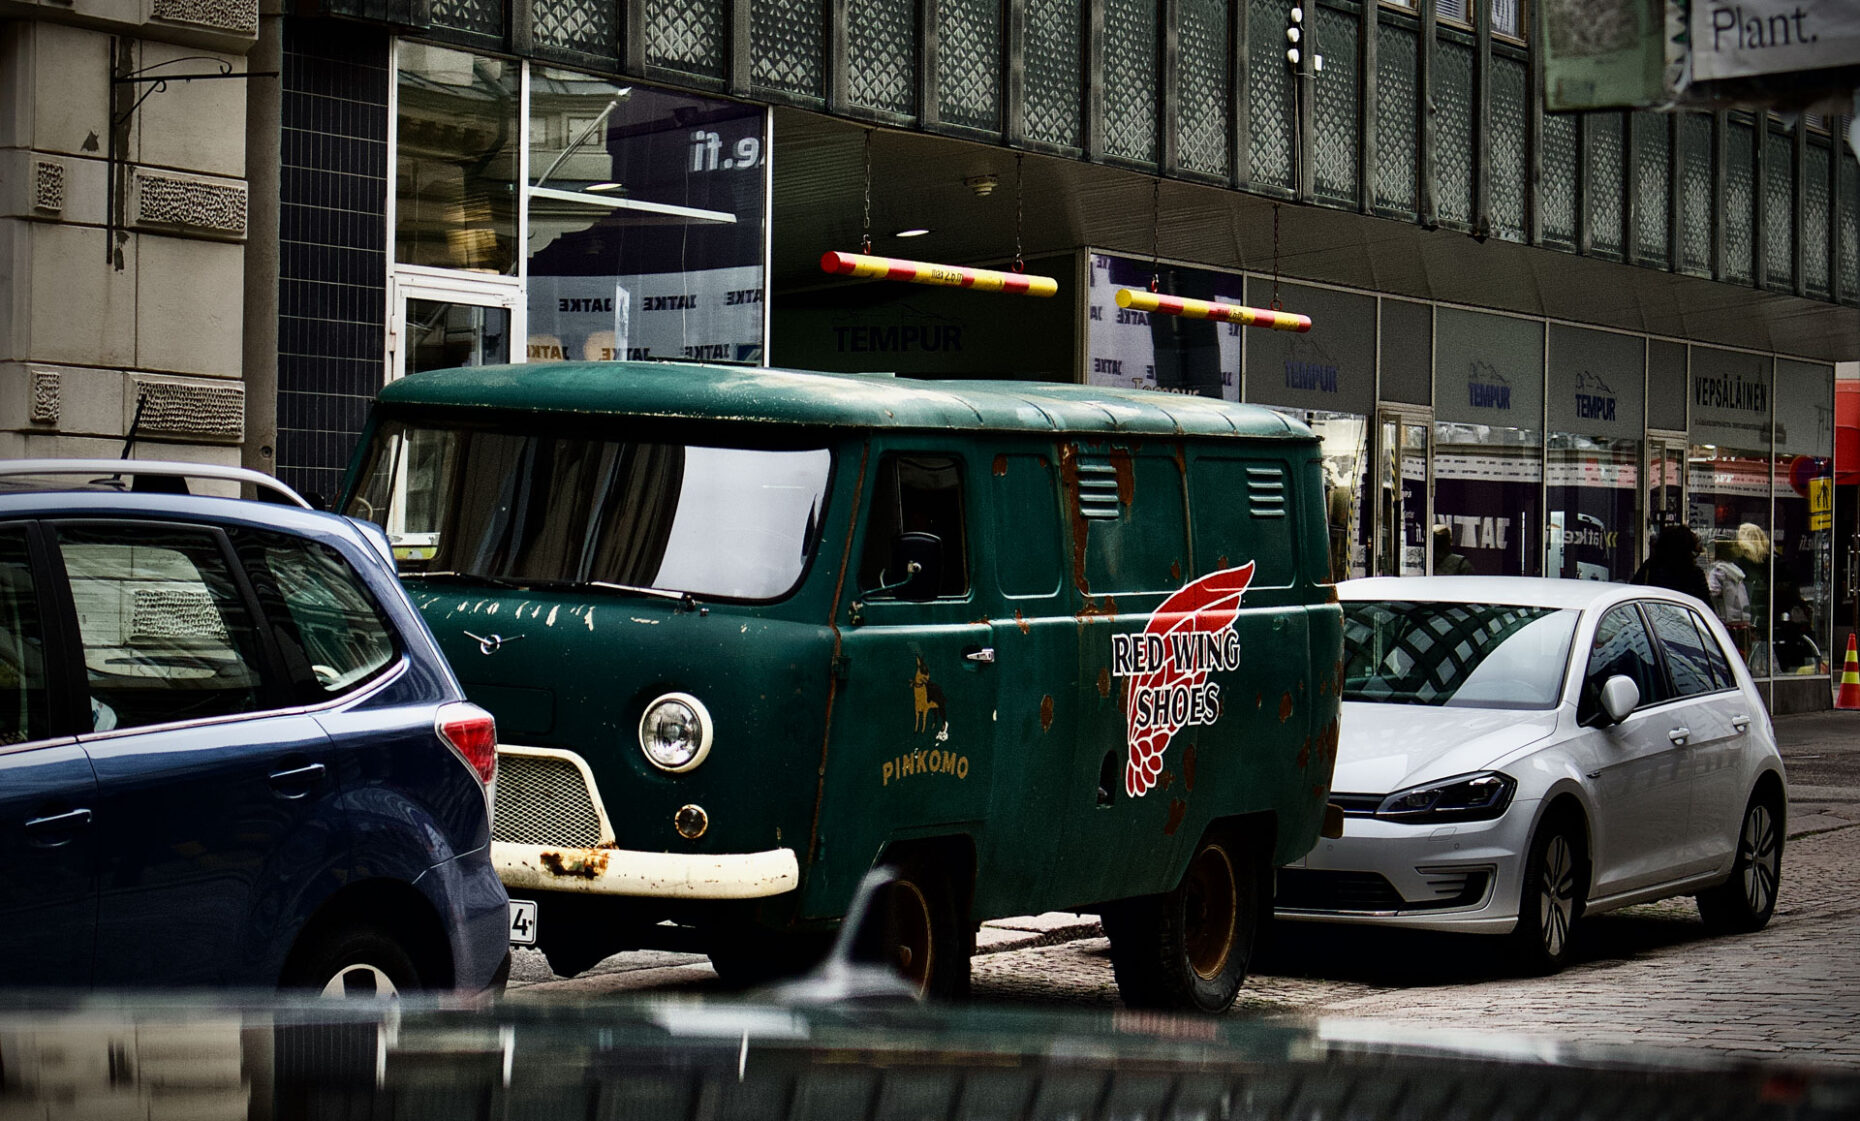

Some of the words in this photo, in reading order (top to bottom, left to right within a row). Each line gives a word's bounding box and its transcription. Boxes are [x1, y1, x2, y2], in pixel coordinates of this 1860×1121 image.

[1712, 4, 1818, 53] Plant.
[833, 325, 963, 353] TEMPUR
[1285, 359, 1338, 393] TEMPUR
[1695, 373, 1767, 412] VEPSÄLÄINEN
[1469, 382, 1511, 410] TEMPUR
[1575, 394, 1616, 422] TEMPUR
[1112, 633, 1166, 675] RED
[1171, 629, 1240, 672] WING
[1134, 682, 1220, 731] SHOES
[882, 749, 969, 786] PINKOMO
[511, 908, 528, 937] 4
